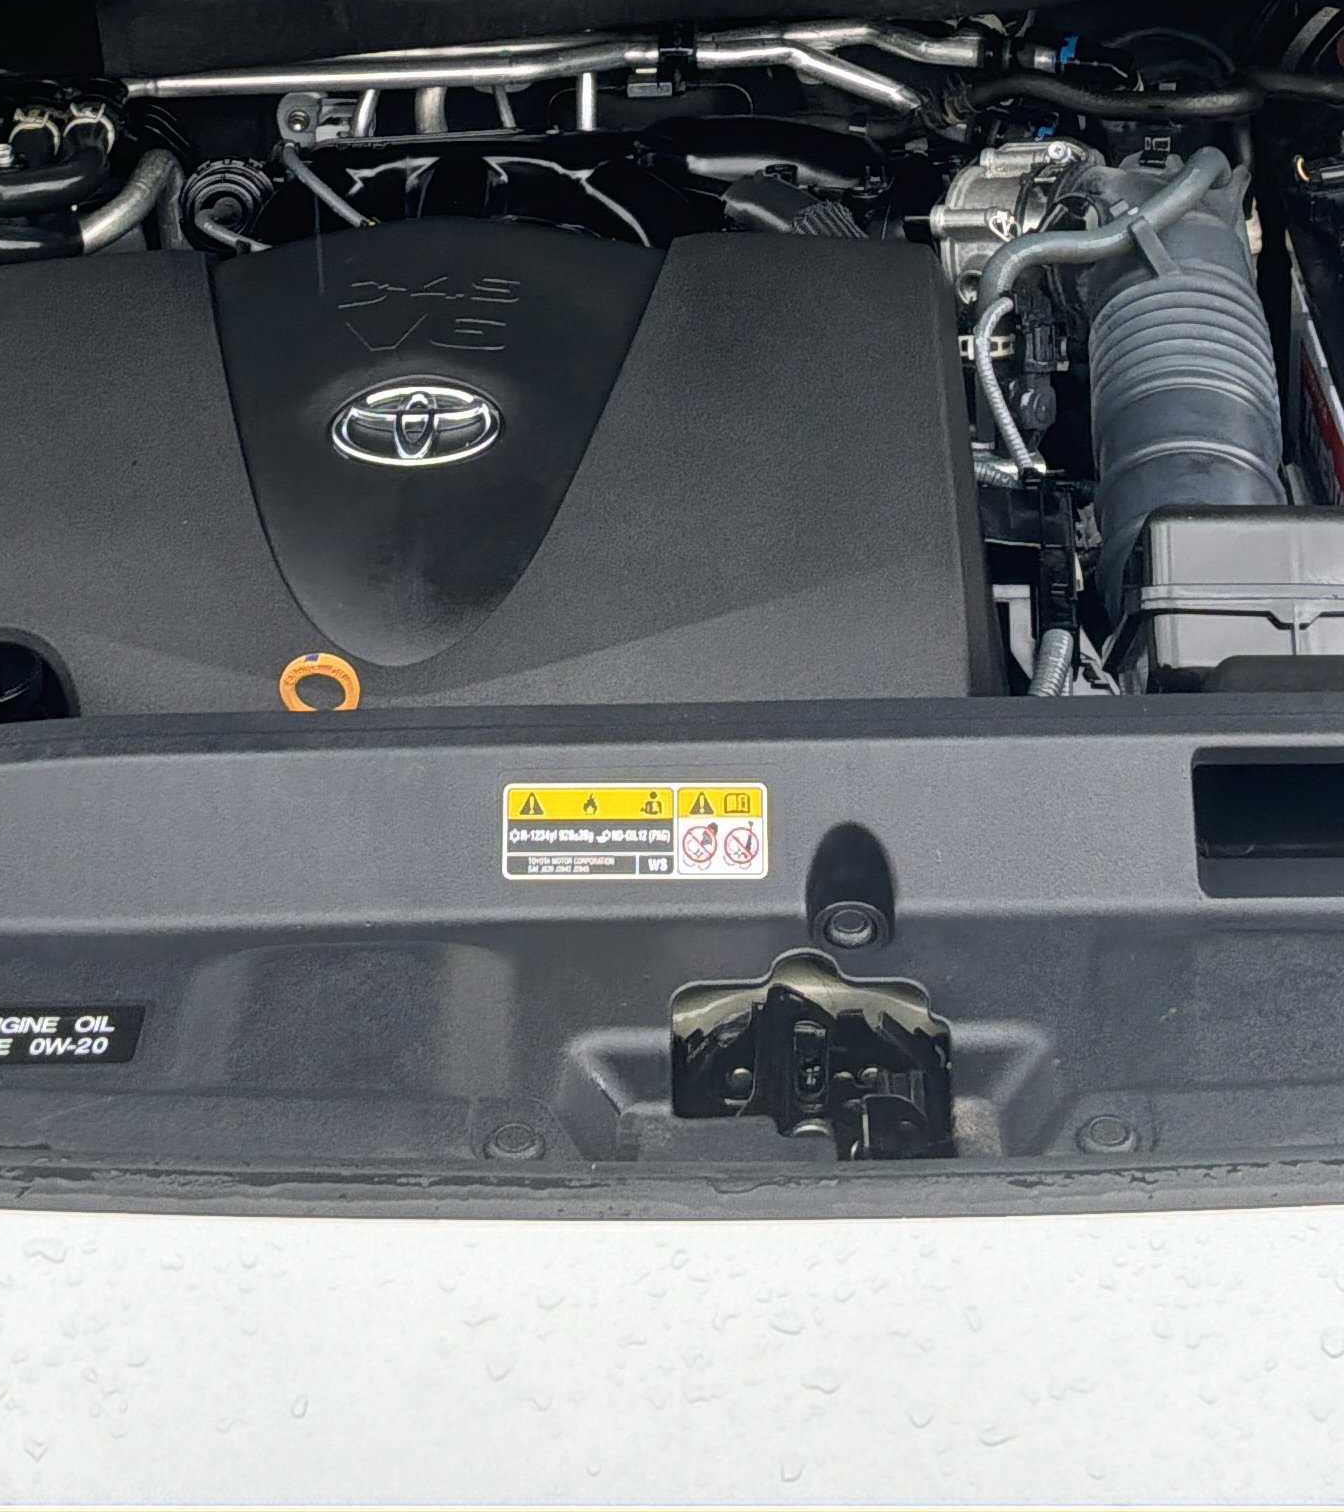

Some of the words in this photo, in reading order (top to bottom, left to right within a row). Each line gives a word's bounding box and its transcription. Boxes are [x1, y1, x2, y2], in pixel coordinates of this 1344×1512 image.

[648, 859, 668, 871] WS
[74, 1016, 115, 1033] OIL
[30, 1037, 108, 1055] 0W-20
